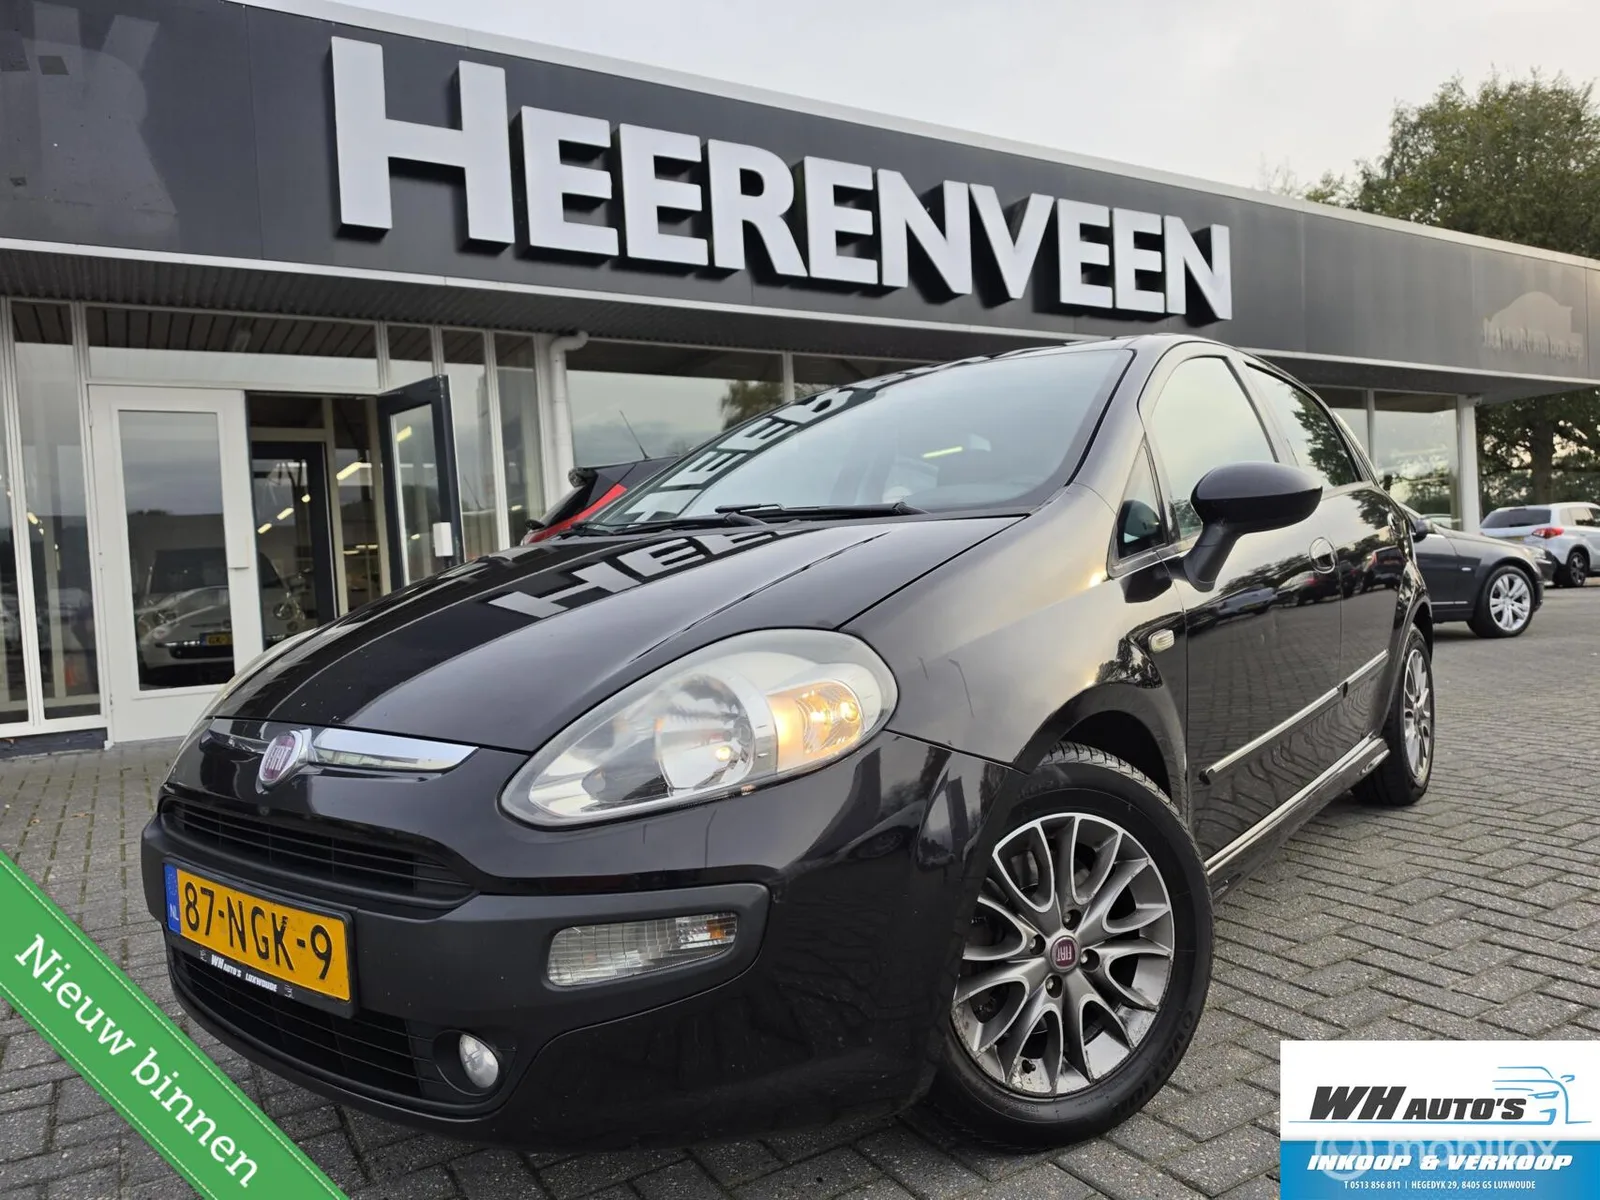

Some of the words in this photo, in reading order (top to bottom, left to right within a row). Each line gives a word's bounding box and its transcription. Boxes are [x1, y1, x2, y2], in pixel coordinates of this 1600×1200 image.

[331, 36, 1232, 320] HEERENVEEN
[169, 902, 180, 922] NL
[184, 881, 333, 981] 87-NGK-9
[211, 953, 225, 970] WH
